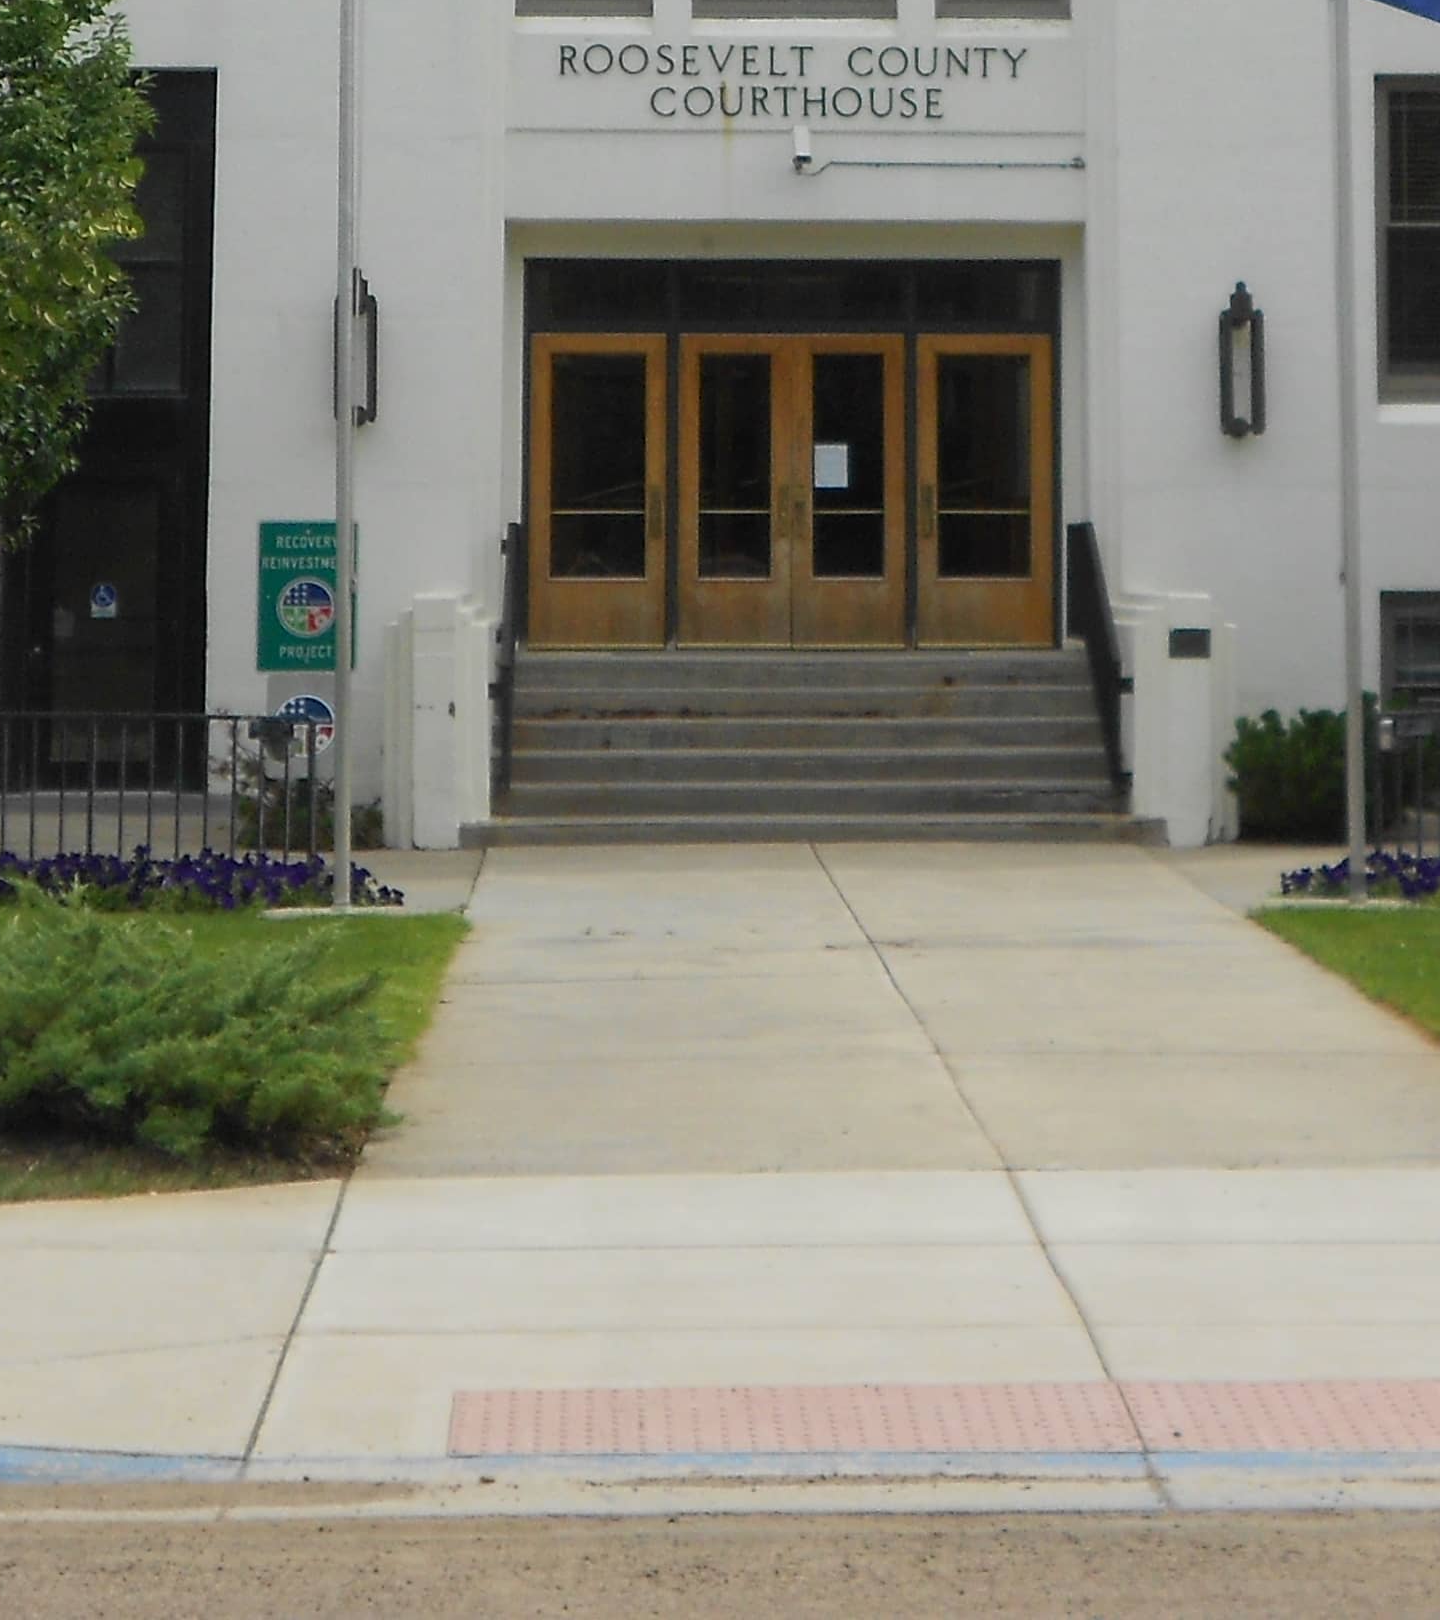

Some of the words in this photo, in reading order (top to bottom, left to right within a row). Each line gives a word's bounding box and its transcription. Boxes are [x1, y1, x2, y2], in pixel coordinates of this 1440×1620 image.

[559, 43, 814, 78] ROOSEVELT
[847, 46, 1029, 79] COUNTY
[649, 85, 945, 119] COURTHOUSE
[261, 556, 337, 570] REINVESTME
[278, 645, 333, 659] PROJECT
